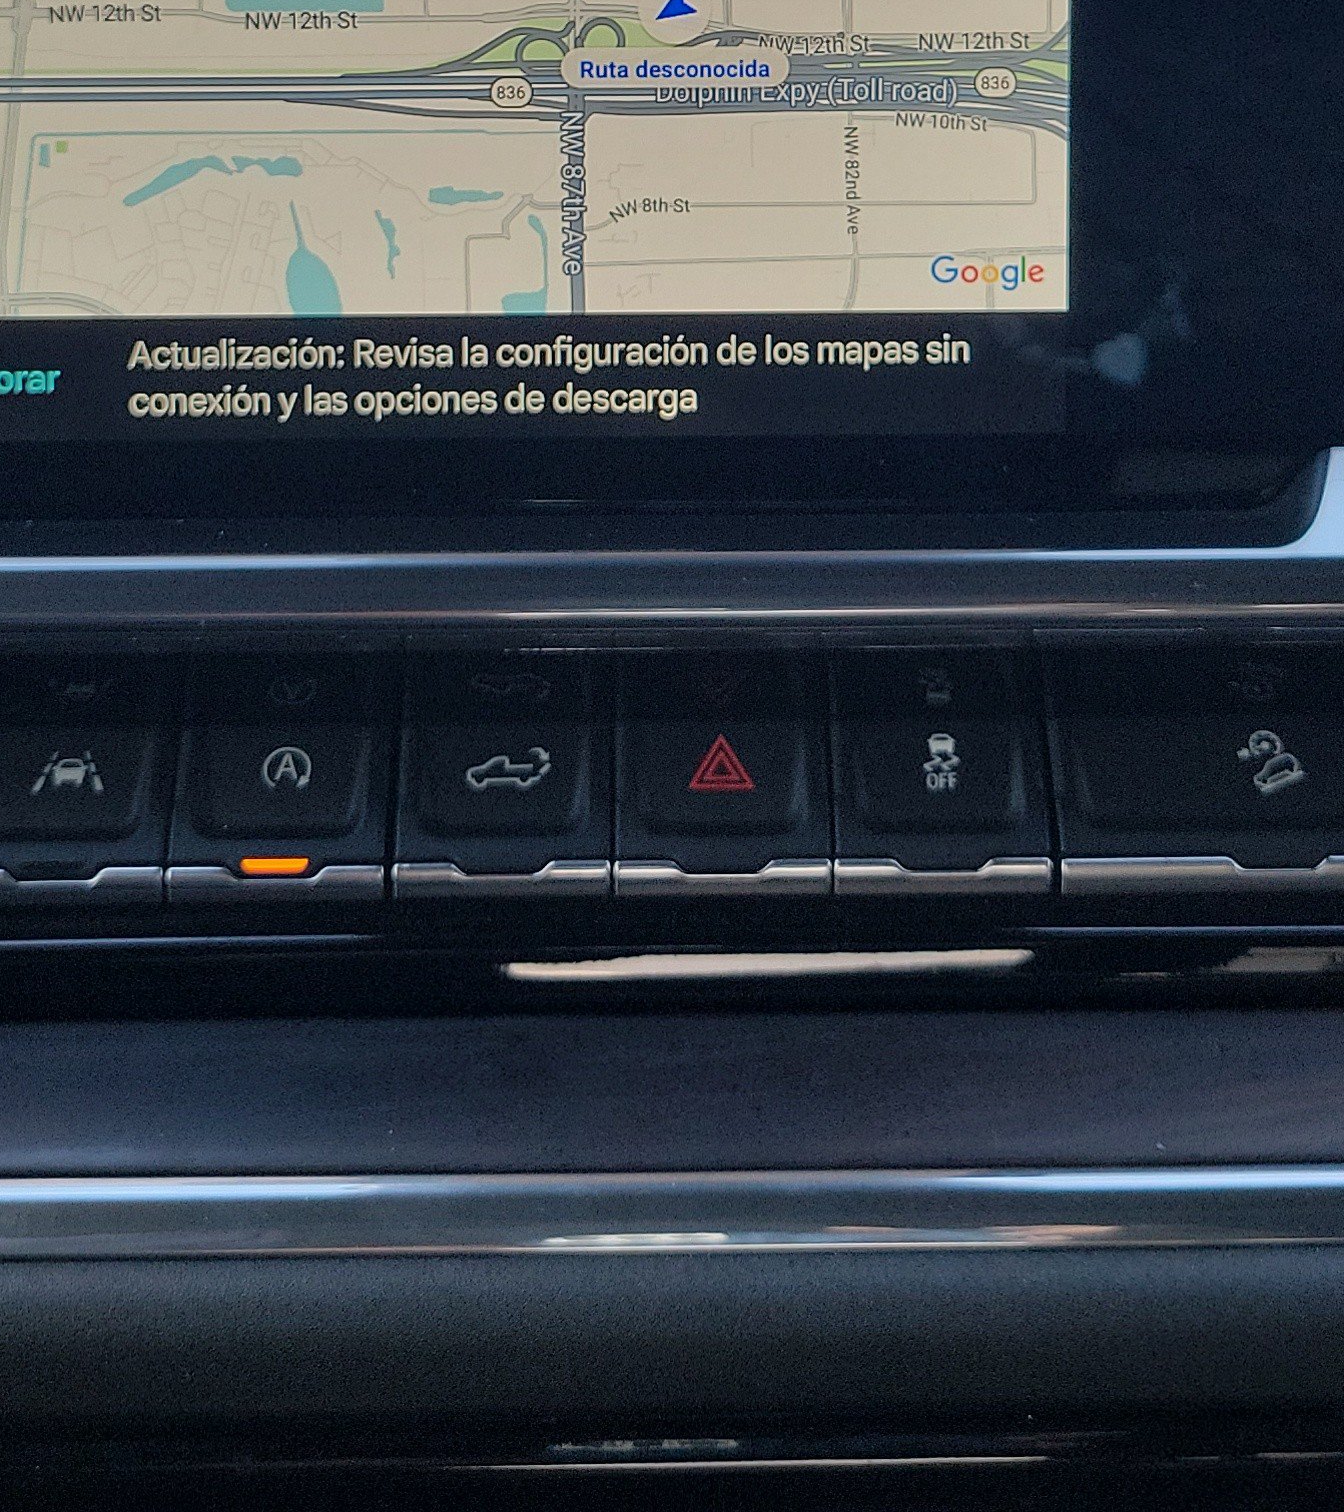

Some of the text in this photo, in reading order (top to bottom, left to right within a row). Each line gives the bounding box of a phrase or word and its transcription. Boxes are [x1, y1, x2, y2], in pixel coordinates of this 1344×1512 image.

[50, 4, 162, 22] NW 12th St
[245, 12, 358, 29] NW 12th St
[801, 35, 844, 53] 12th
[850, 35, 870, 52] St
[918, 33, 1030, 50] NW 12th St
[580, 59, 770, 78] Ruta desconocida
[656, 77, 957, 107] Dolphin Expy (Toll road)
[980, 75, 1010, 90] 836
[496, 84, 526, 101] 836
[895, 113, 987, 132] NW 10th St
[844, 126, 862, 234] NW 82nd Ave
[560, 112, 587, 275] NW 87th Ave
[609, 197, 690, 223] NW 8th St
[930, 255, 1046, 290] Google
[128, 333, 971, 375] Actualización: Revisa la configuración de los mapas sin
[128, 382, 699, 422] conexión y las opciones de descarga
[926, 772, 958, 790] OFF
